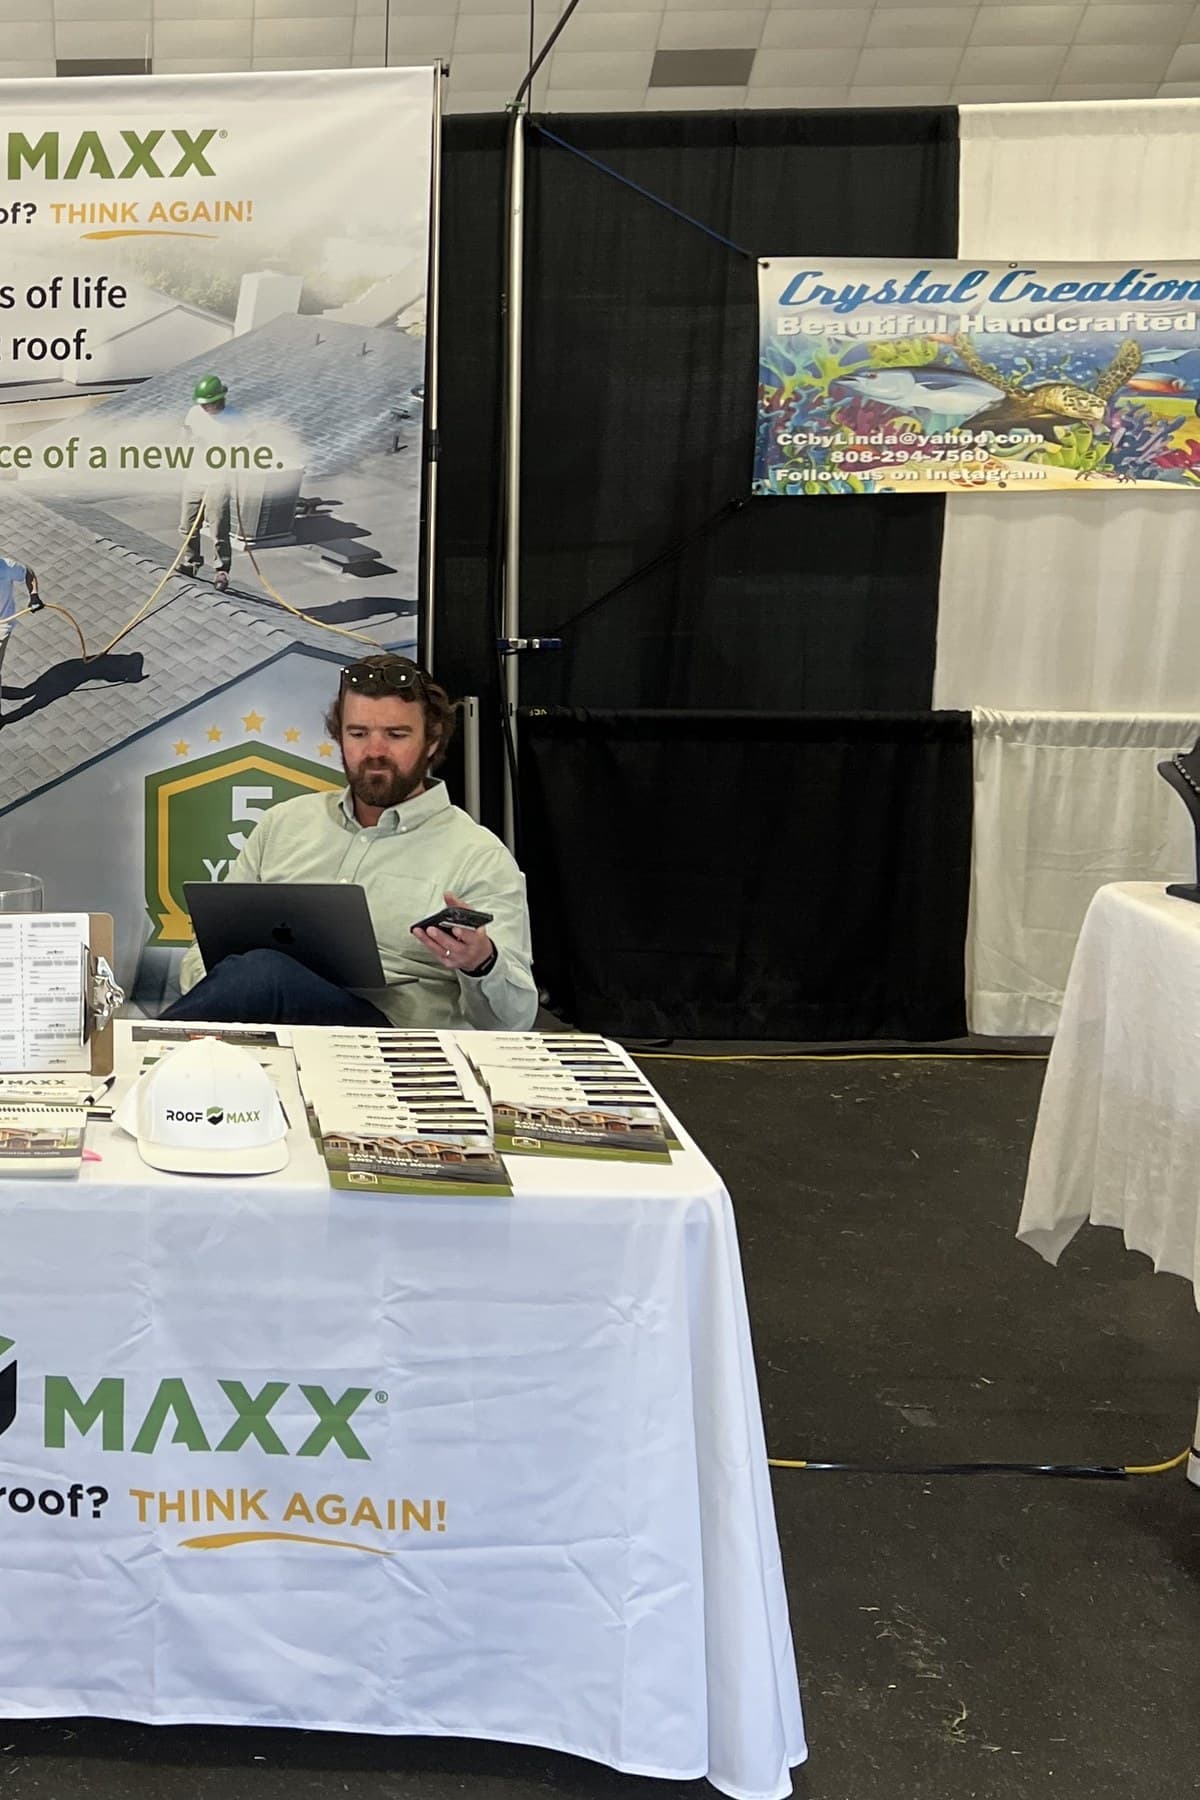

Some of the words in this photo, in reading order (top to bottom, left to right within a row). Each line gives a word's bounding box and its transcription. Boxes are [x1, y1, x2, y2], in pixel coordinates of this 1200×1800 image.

[50, 202, 140, 225] THINK
[147, 200, 253, 224] AGAIN!
[26, 276, 63, 309] of
[72, 276, 128, 309] life
[778, 269, 990, 314] Crystal
[776, 314, 949, 337] Beautiful
[959, 310, 1197, 336] Handcrafted
[11, 328, 94, 361] roof.
[43, 437, 80, 469] of
[89, 444, 108, 469] a
[119, 445, 195, 469] new
[205, 445, 285, 469] one.
[830, 450, 989, 464] 808-294-7560
[776, 469, 849, 482] Follow
[857, 470, 885, 482] us
[890, 470, 920, 482] on
[926, 469, 1047, 483] Instagram
[166, 1109, 203, 1123] ROOF
[226, 1110, 260, 1124] MAXX
[128, 1488, 270, 1524] THINK
[282, 1492, 447, 1532] AGAIN!
